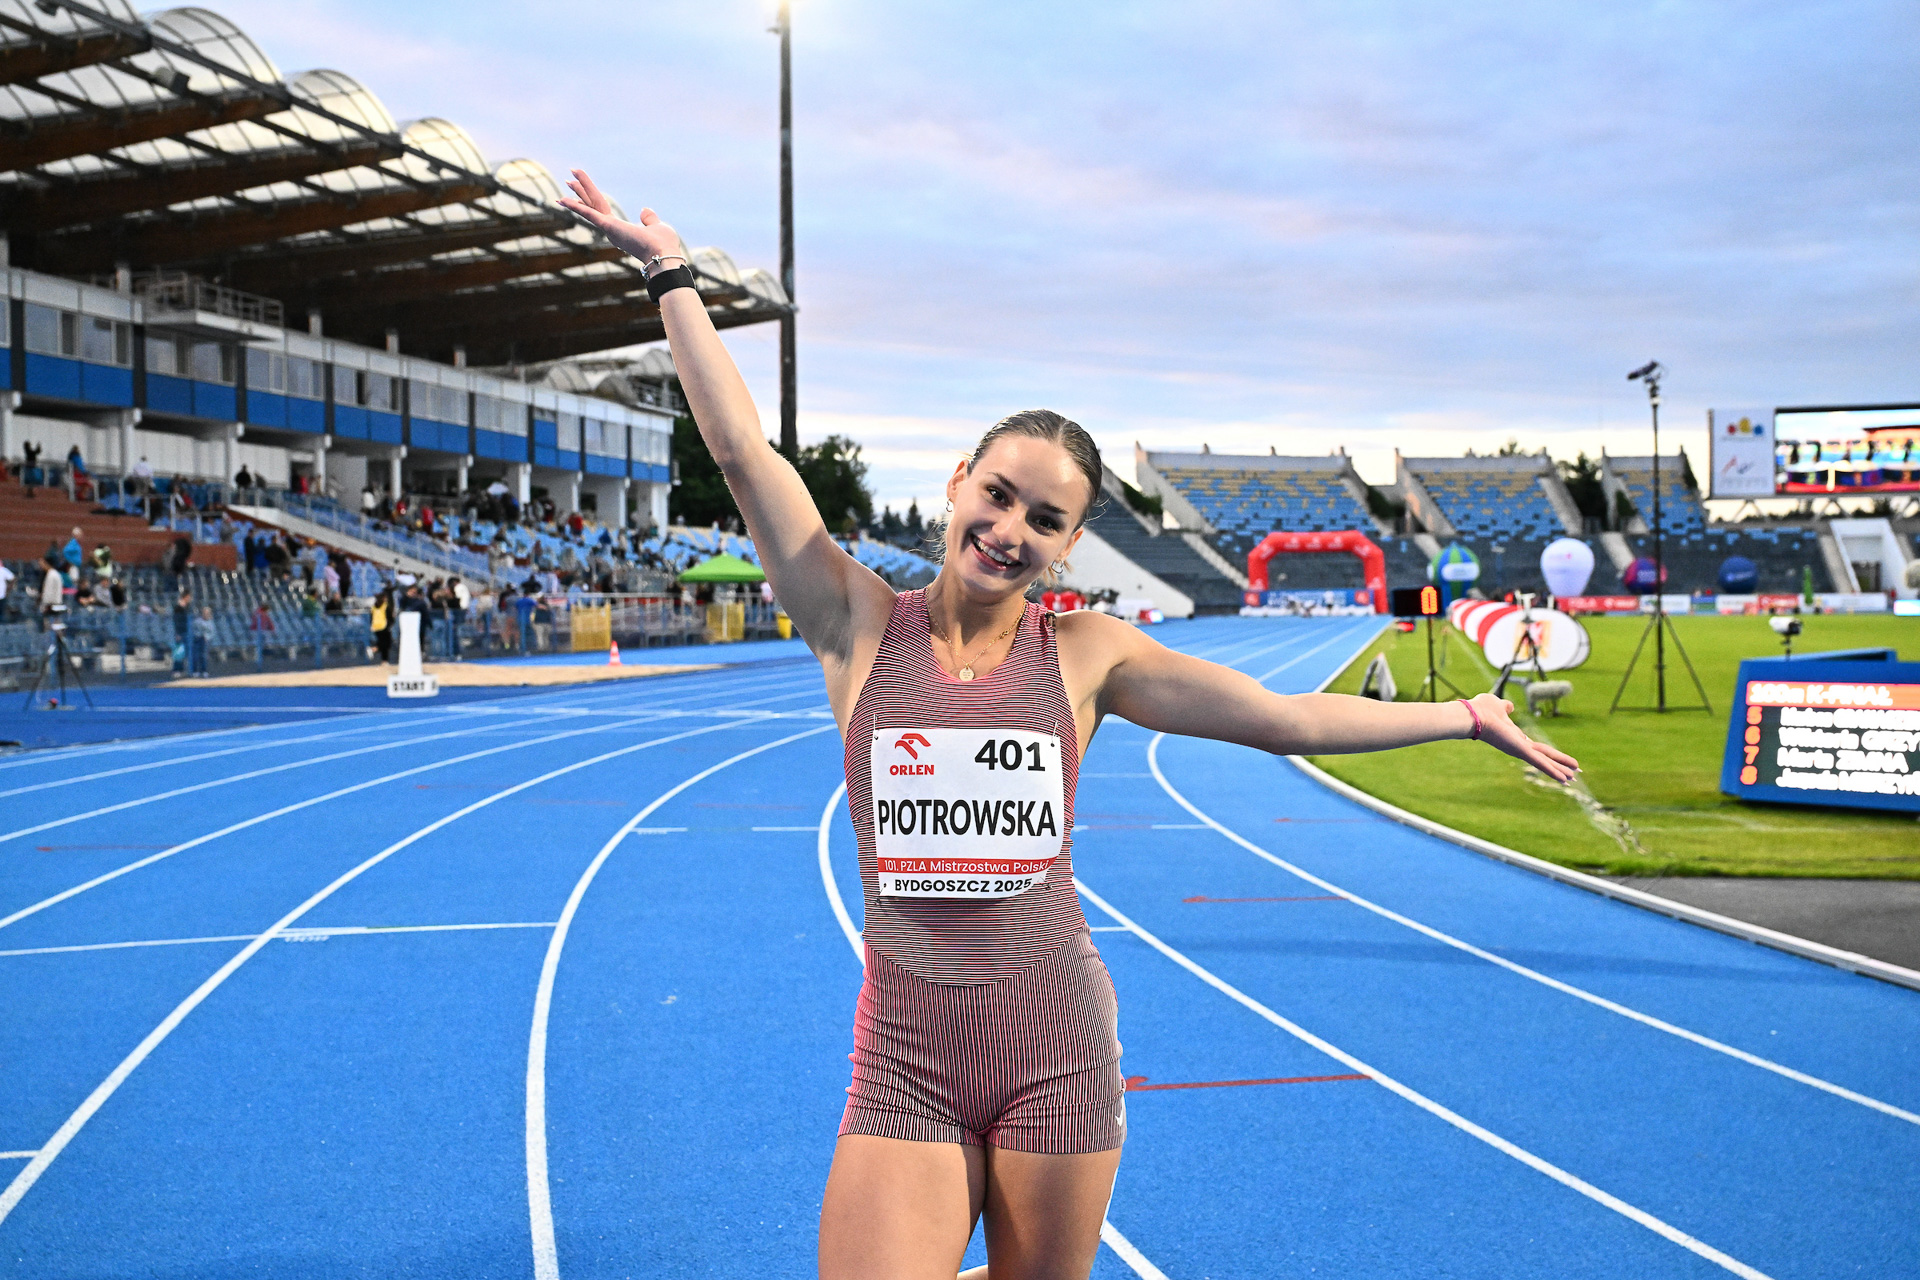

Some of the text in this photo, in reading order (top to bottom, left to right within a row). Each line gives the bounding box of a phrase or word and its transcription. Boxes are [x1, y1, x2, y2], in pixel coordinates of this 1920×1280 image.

[392, 681, 425, 692] START
[1745, 725, 1761, 745] 6
[974, 739, 1046, 772] 401
[1744, 745, 1760, 765] 7
[889, 765, 935, 776] ORLEN
[1740, 765, 1758, 785] 8
[878, 799, 1057, 837] PIOTROWSKA
[900, 861, 927, 872] PZLA
[930, 859, 1010, 873] Mistrzostwa
[1013, 859, 1049, 873] Polski
[895, 878, 1033, 893] BYDGOSZCZ 2025
